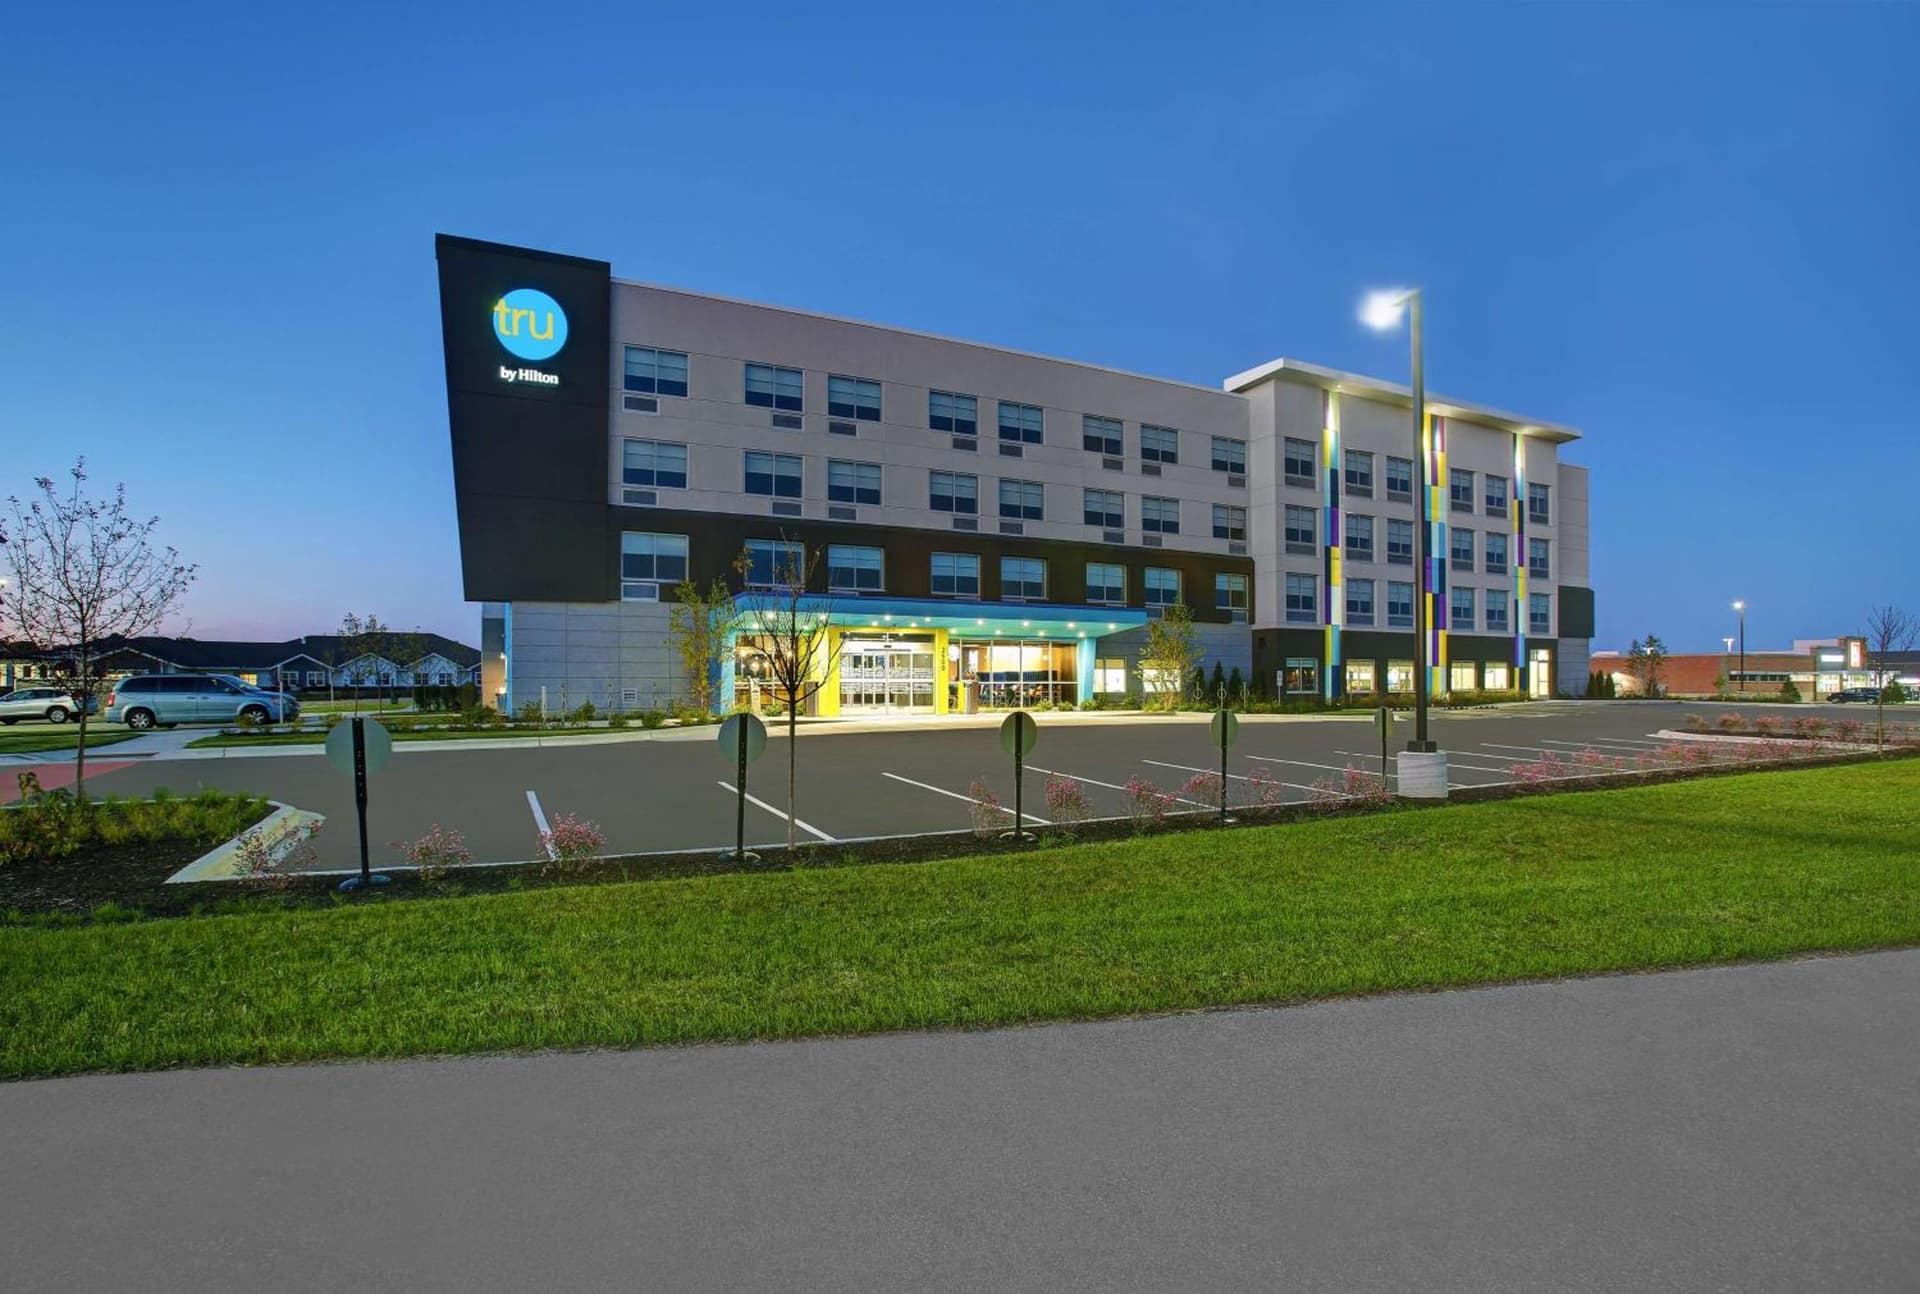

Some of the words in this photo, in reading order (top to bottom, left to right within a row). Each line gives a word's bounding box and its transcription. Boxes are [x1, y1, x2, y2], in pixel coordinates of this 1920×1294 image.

[492, 298, 554, 339] tru
[500, 365, 517, 382] by
[518, 368, 559, 384] Hilton
